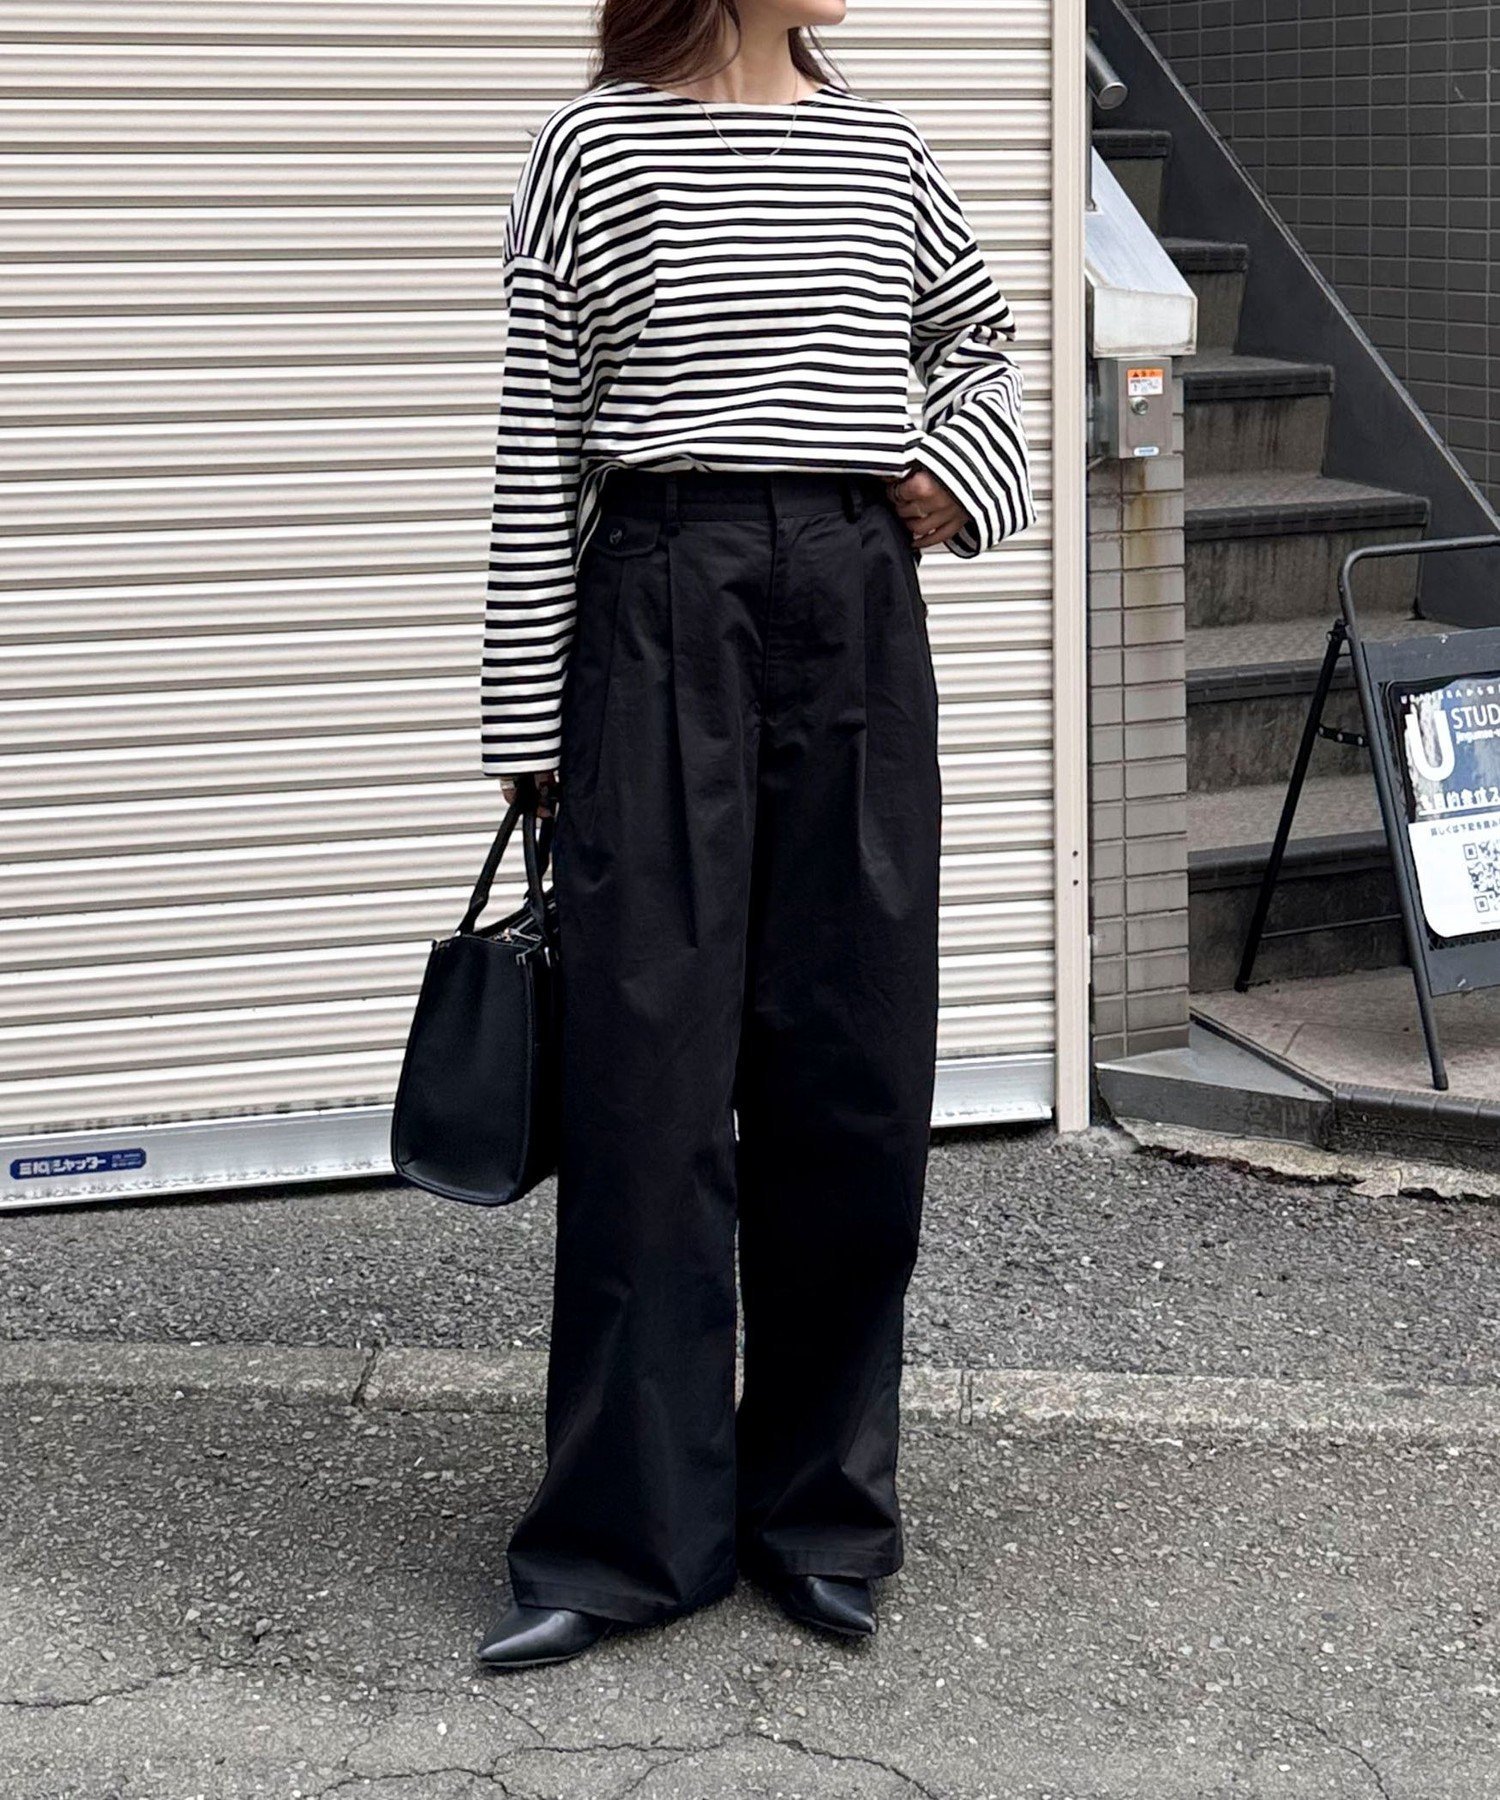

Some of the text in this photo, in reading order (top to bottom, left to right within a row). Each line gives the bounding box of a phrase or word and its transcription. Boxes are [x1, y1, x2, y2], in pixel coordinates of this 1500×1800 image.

[1405, 710, 1455, 781] U
[19, 1156, 106, 1175] 三和シャッター
